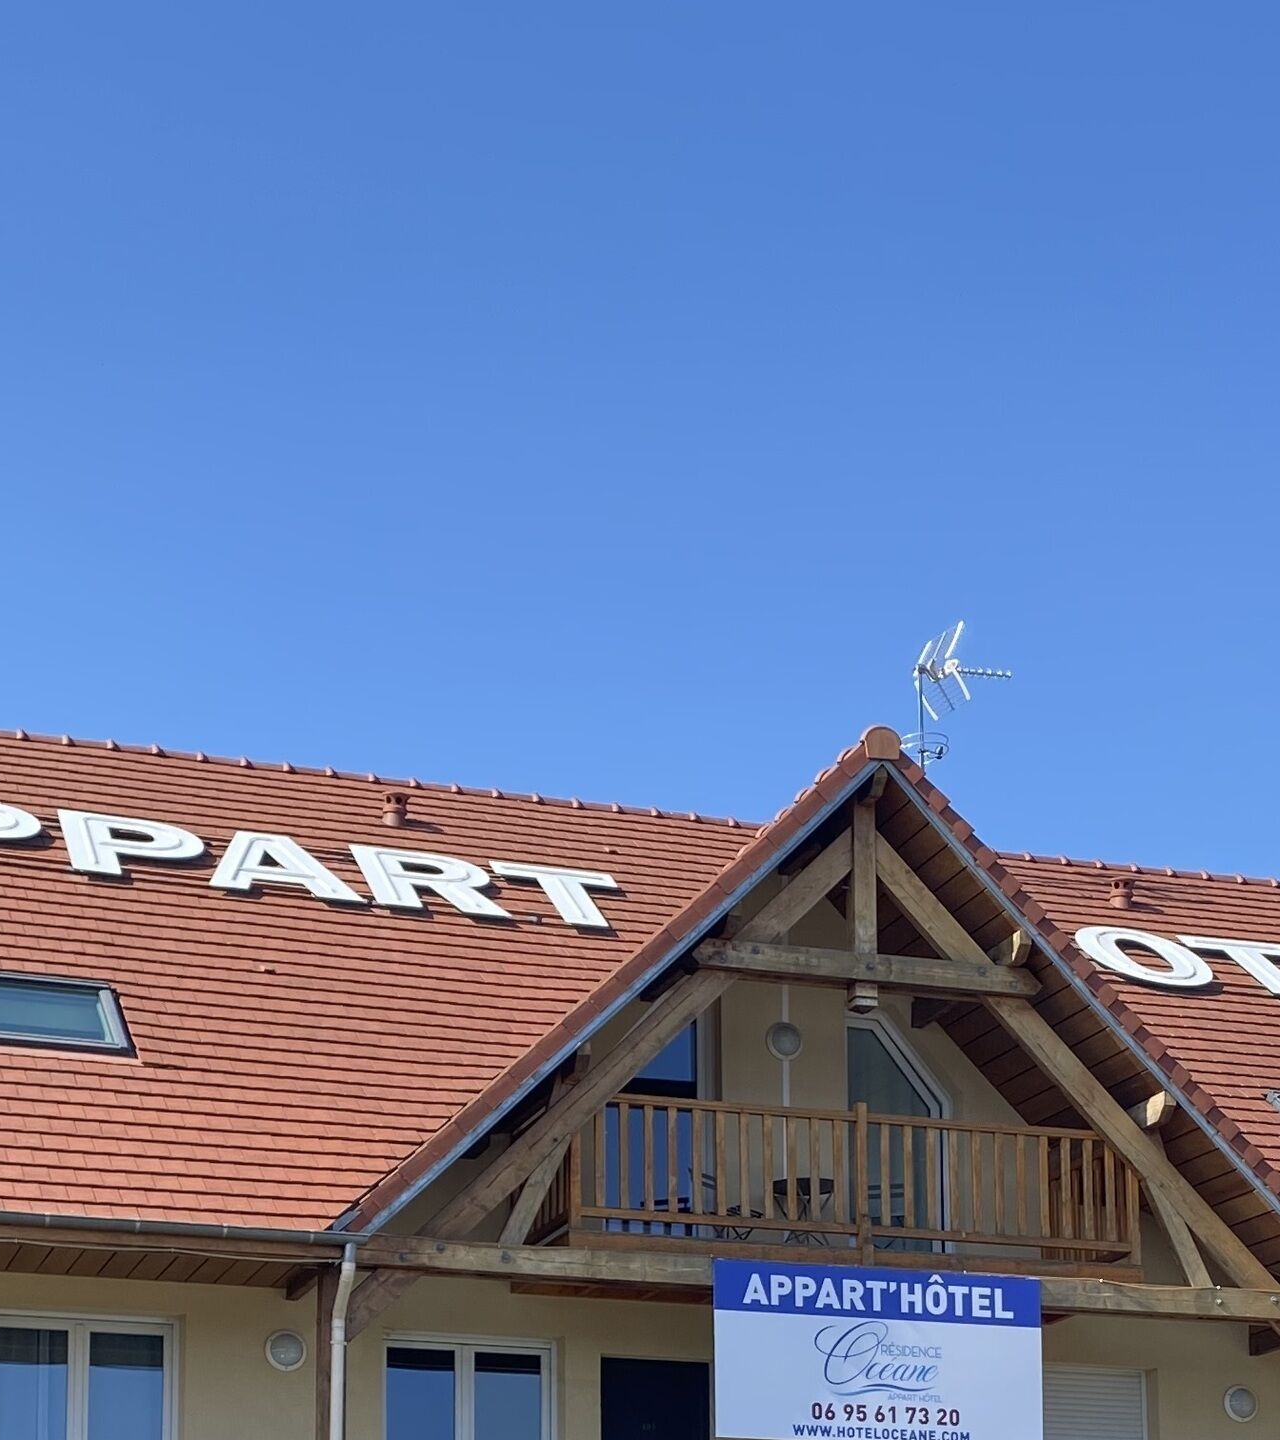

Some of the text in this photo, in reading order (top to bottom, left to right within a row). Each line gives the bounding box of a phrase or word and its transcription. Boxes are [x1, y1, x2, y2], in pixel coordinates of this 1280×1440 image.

[742, 1273, 1015, 1320] APPART'HÔTEL
[814, 1320, 940, 1385] Océane
[880, 1342, 943, 1360] RÉSIDENCE
[811, 1402, 960, 1427] 06 95 61 73 20
